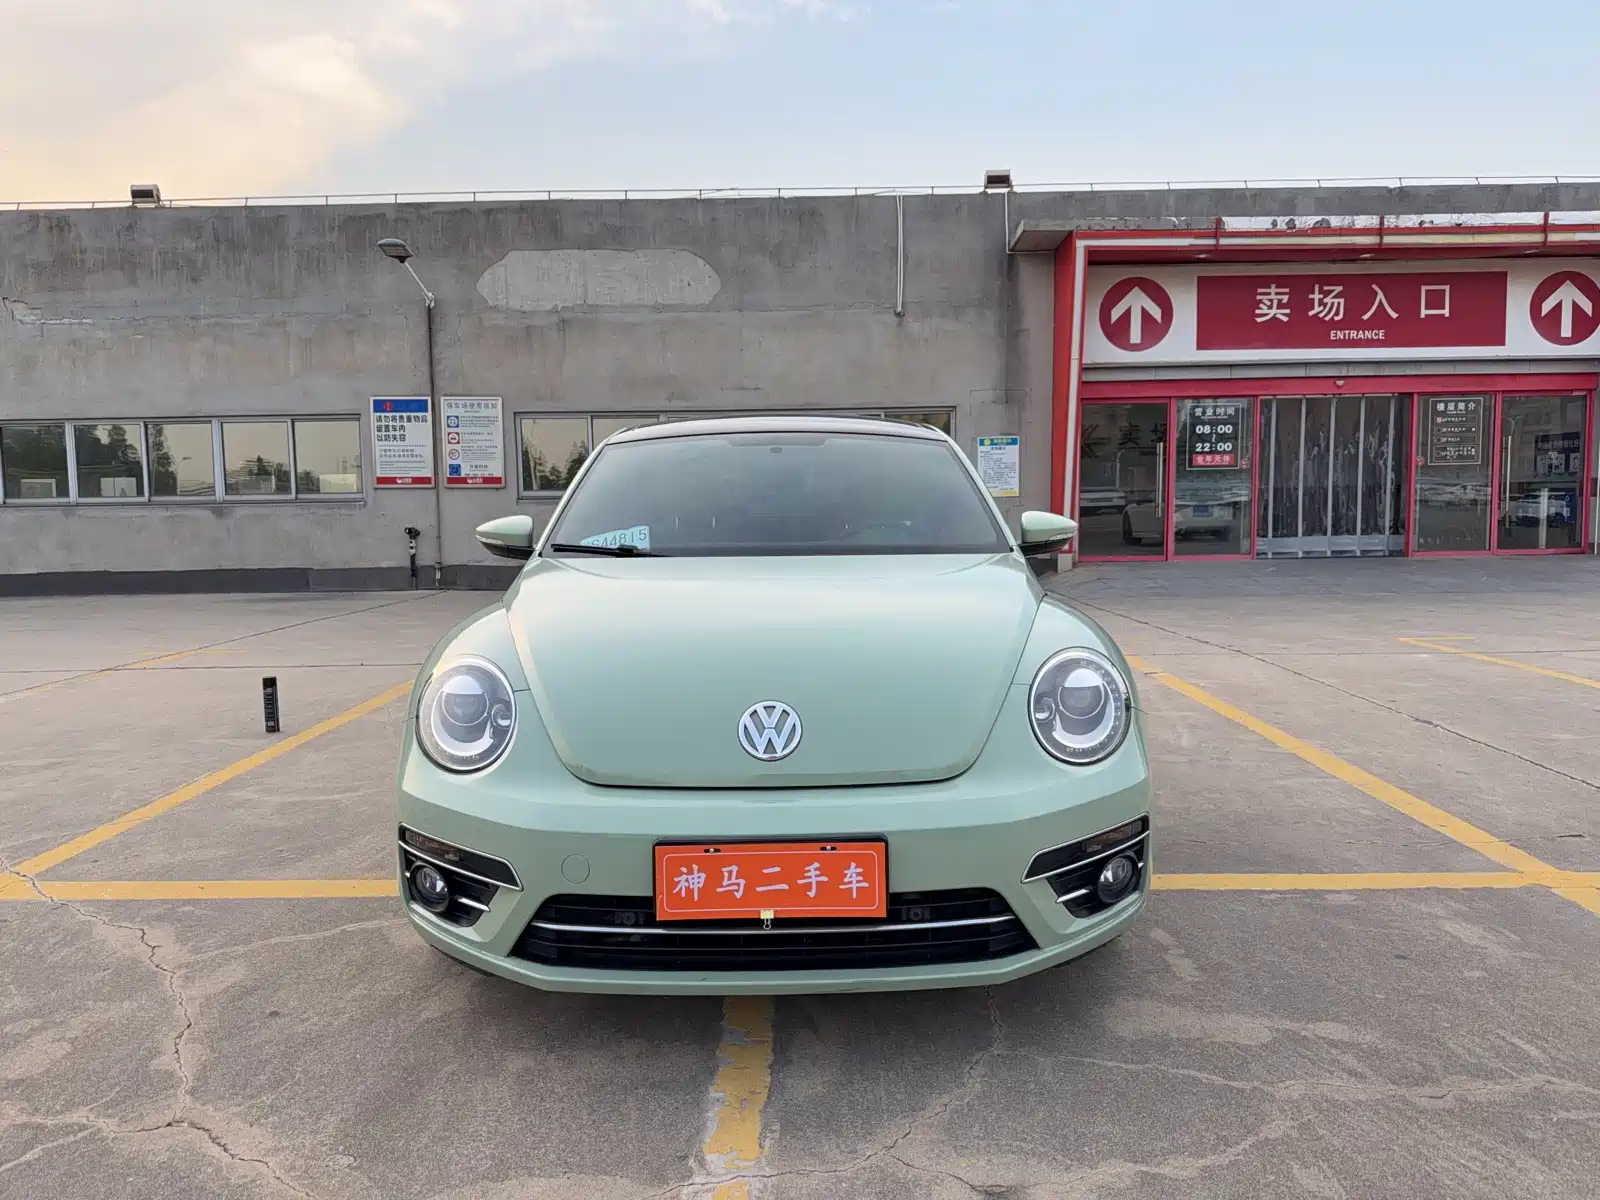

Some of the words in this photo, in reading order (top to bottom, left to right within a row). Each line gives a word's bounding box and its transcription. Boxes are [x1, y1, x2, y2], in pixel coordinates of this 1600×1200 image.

[1254, 283, 1451, 322] 卖场入口
[1330, 330, 1386, 340] ENTRANCE
[1194, 407, 1236, 417] 营业时间
[375, 414, 428, 423] 请勿将贵重物品
[376, 424, 406, 433] 留置车内
[1195, 425, 1234, 434] 08:00
[376, 433, 407, 442] 以防失窃
[1195, 442, 1233, 452] 22:00
[672, 861, 870, 902] 神马二手车
